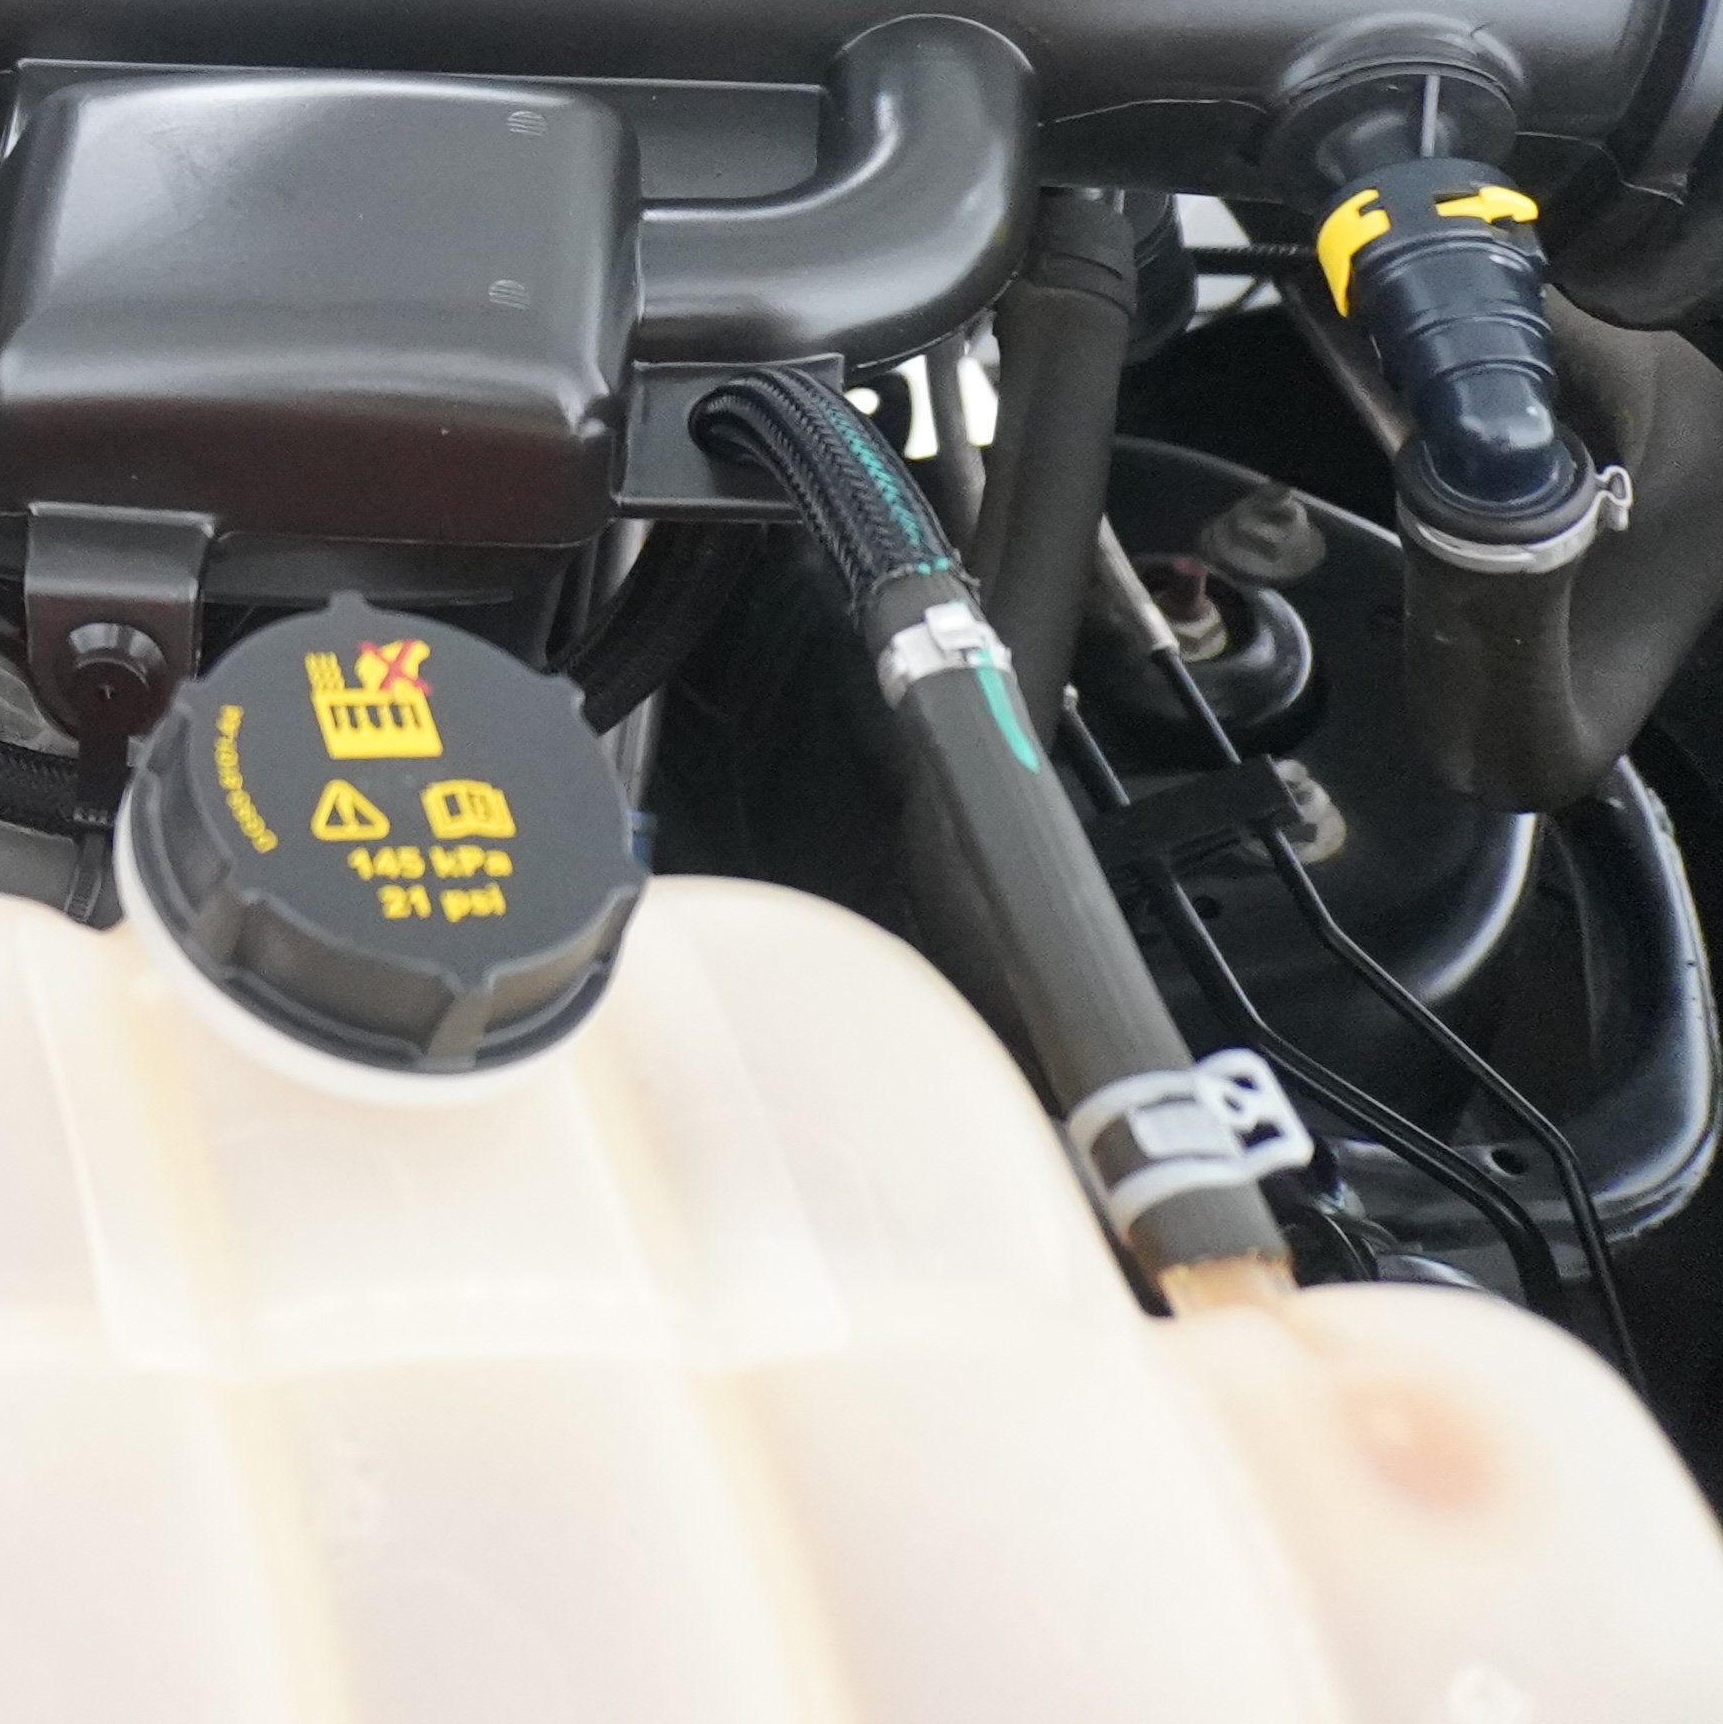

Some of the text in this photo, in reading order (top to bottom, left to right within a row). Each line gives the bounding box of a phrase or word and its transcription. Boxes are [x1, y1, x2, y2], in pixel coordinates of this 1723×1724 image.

[348, 844, 513, 880] 145 kPa
[378, 881, 507, 923] 21 psi
